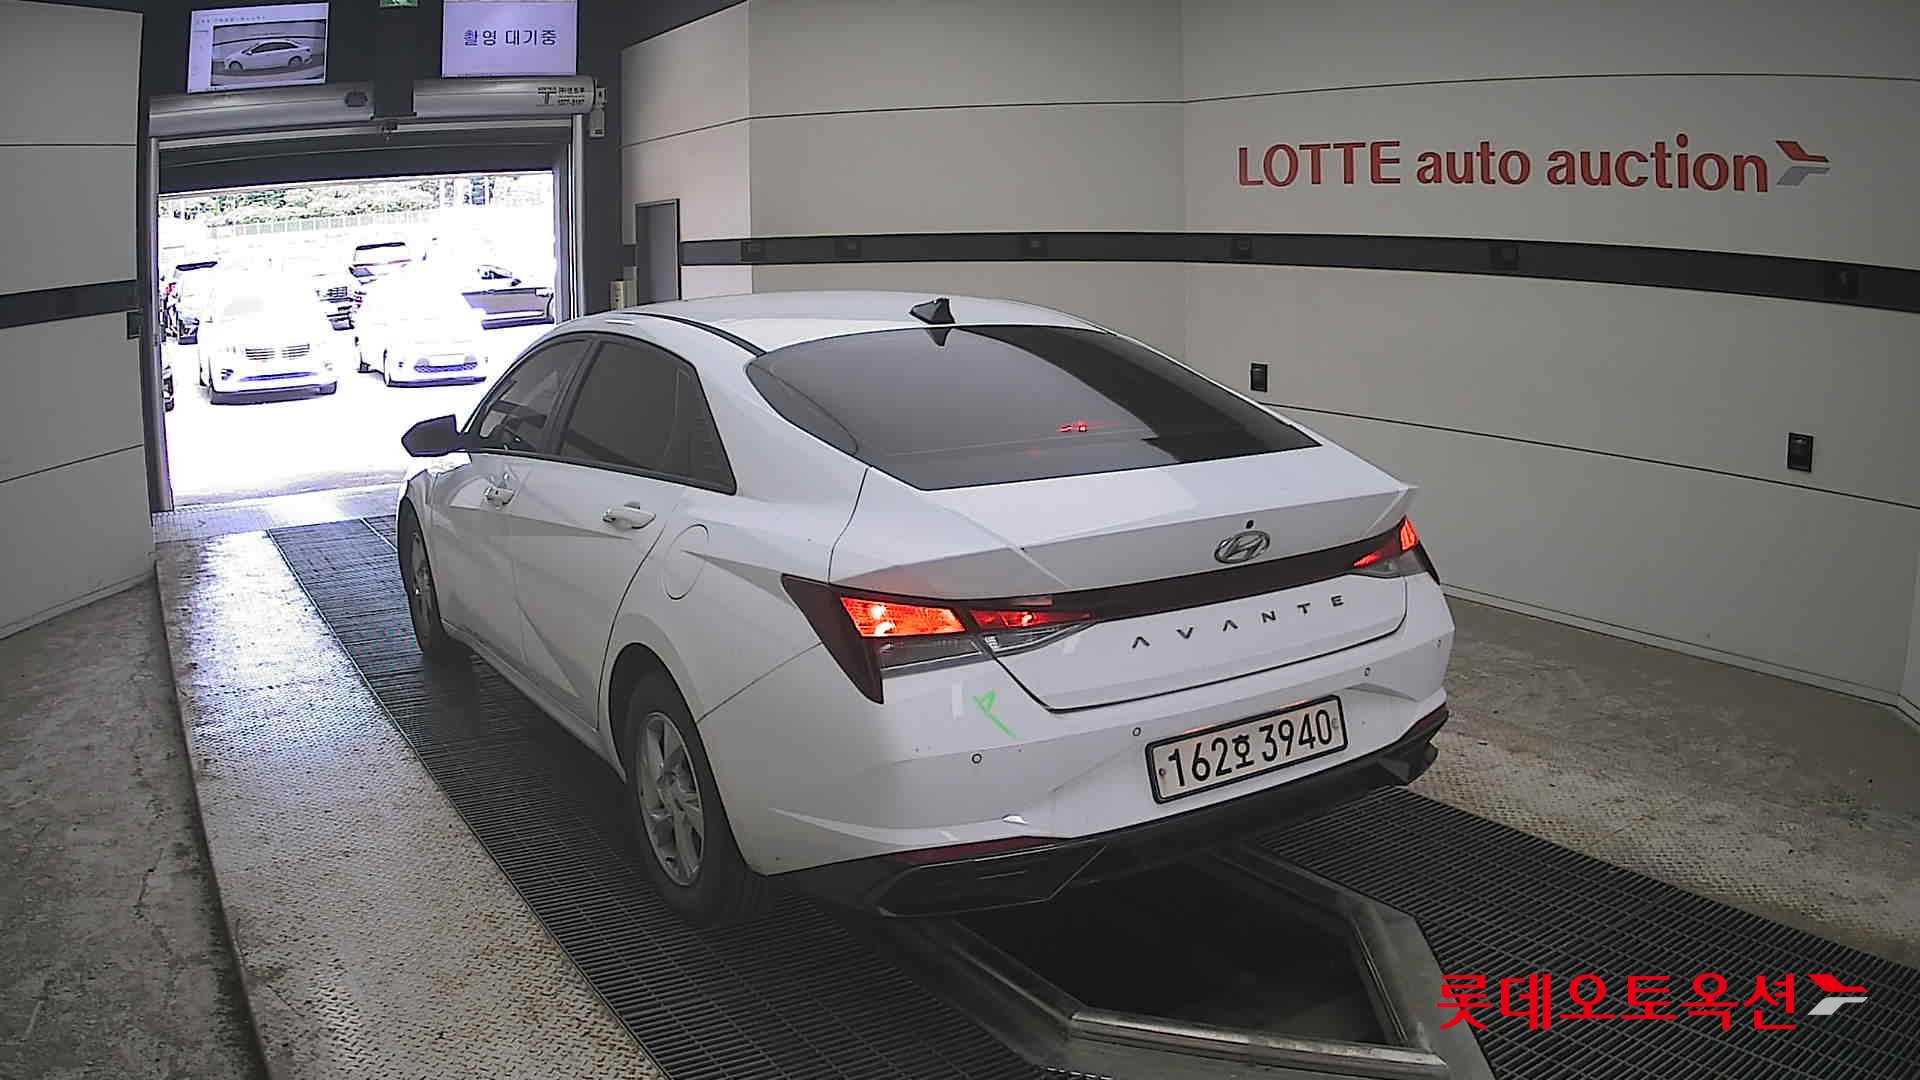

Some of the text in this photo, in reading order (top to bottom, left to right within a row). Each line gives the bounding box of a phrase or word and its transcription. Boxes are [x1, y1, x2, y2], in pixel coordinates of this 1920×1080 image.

[505, 29, 558, 46] 대기중
[1237, 134, 1770, 193] LOTTE auto auction
[1131, 594, 1345, 650] AVANTE
